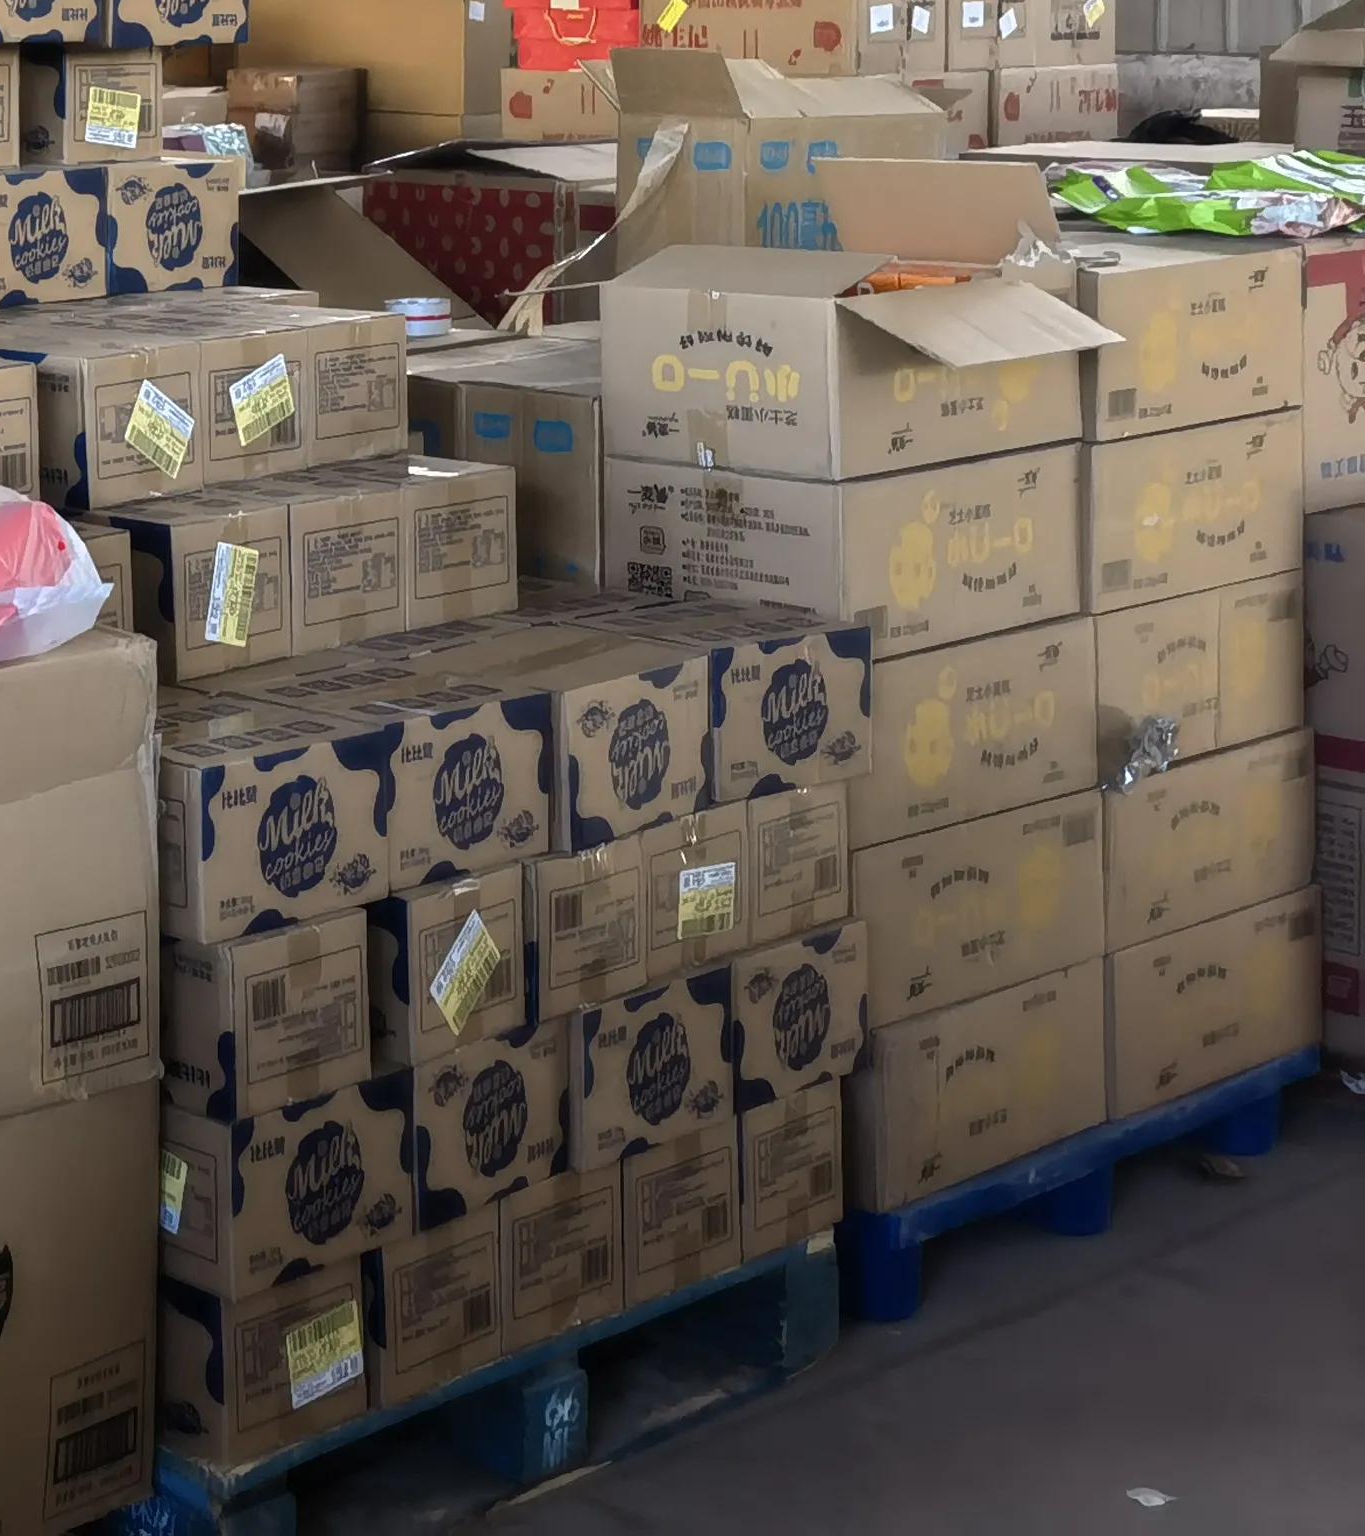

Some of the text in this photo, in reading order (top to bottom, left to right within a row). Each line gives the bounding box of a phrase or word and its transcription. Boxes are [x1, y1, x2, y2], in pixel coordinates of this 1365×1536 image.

[9, 195, 68, 248] Milk
[14, 236, 68, 269] cookies
[726, 404, 797, 426] 芝士小蛋糕
[434, 737, 502, 805] Milk
[259, 777, 335, 851] Milk
[439, 786, 501, 831] cookies
[264, 829, 337, 880] cookies
